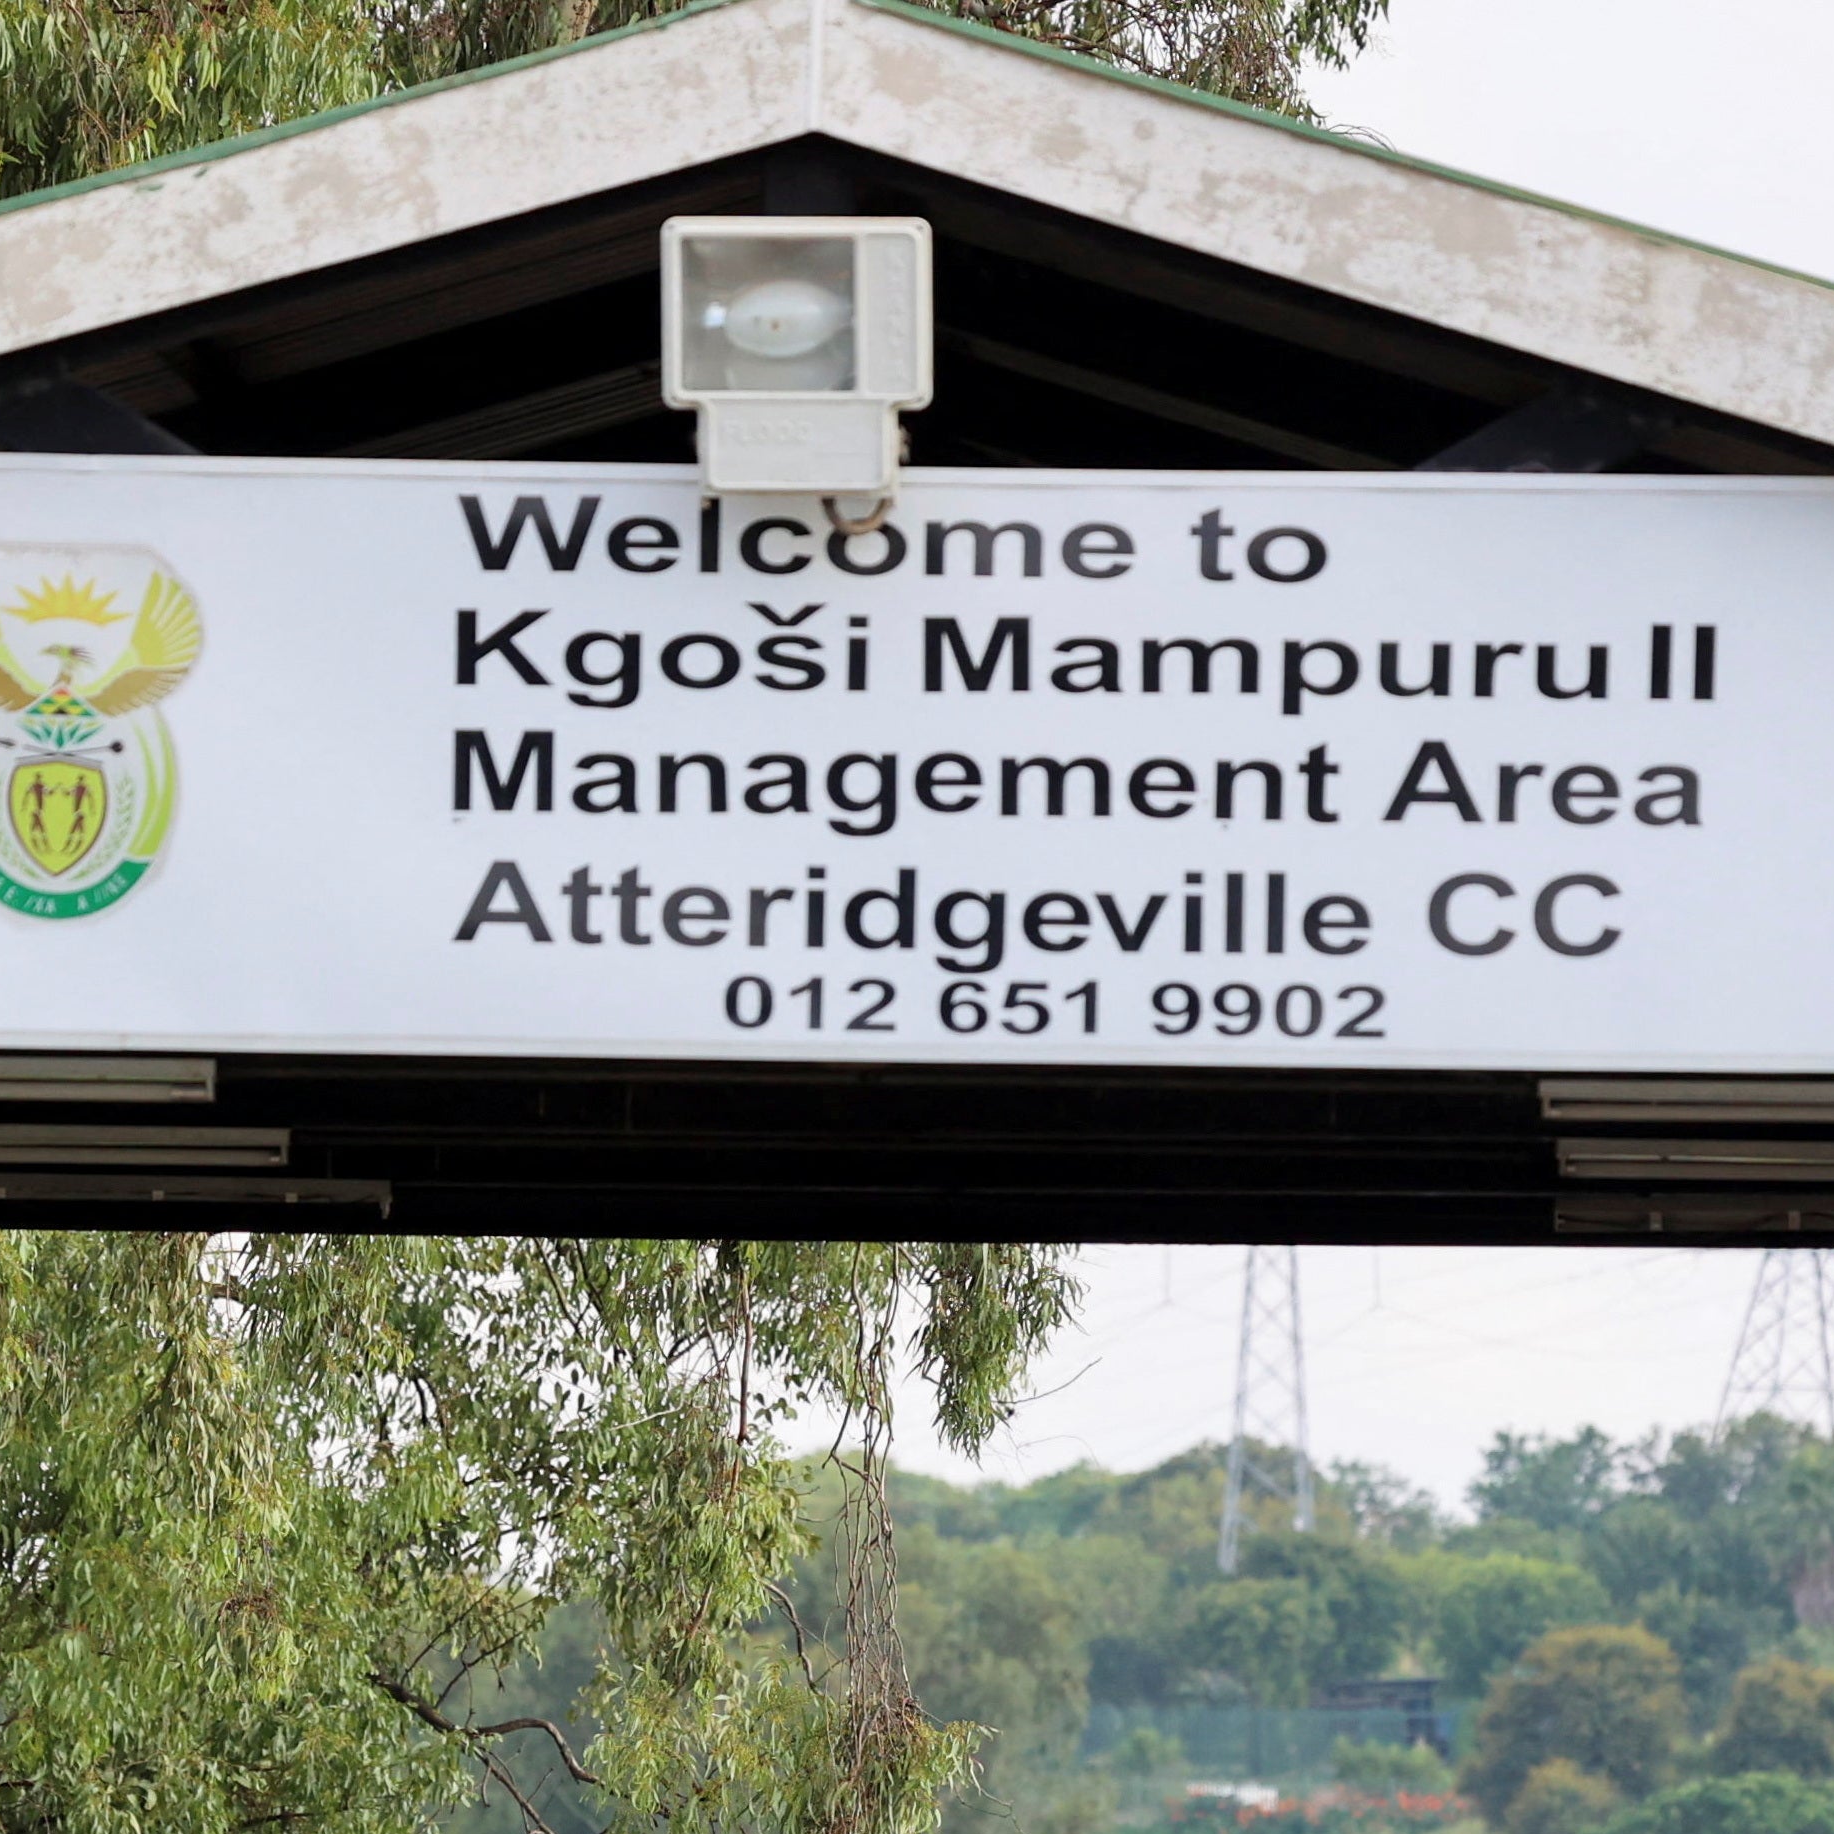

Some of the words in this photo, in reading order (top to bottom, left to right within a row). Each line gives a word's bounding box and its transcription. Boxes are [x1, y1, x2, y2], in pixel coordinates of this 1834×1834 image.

[458, 494, 1135, 580] Welcome
[1190, 509, 1328, 584] to
[455, 601, 869, 711] Kgoši
[923, 616, 1609, 718] Mampuru
[453, 729, 1340, 838] Management
[1382, 740, 1700, 827] Area
[453, 861, 1371, 975] Atteridgeville
[1428, 872, 1621, 958] CC
[724, 975, 896, 1032] 012
[938, 980, 1098, 1036] 651
[1151, 982, 1385, 1038] 9902
